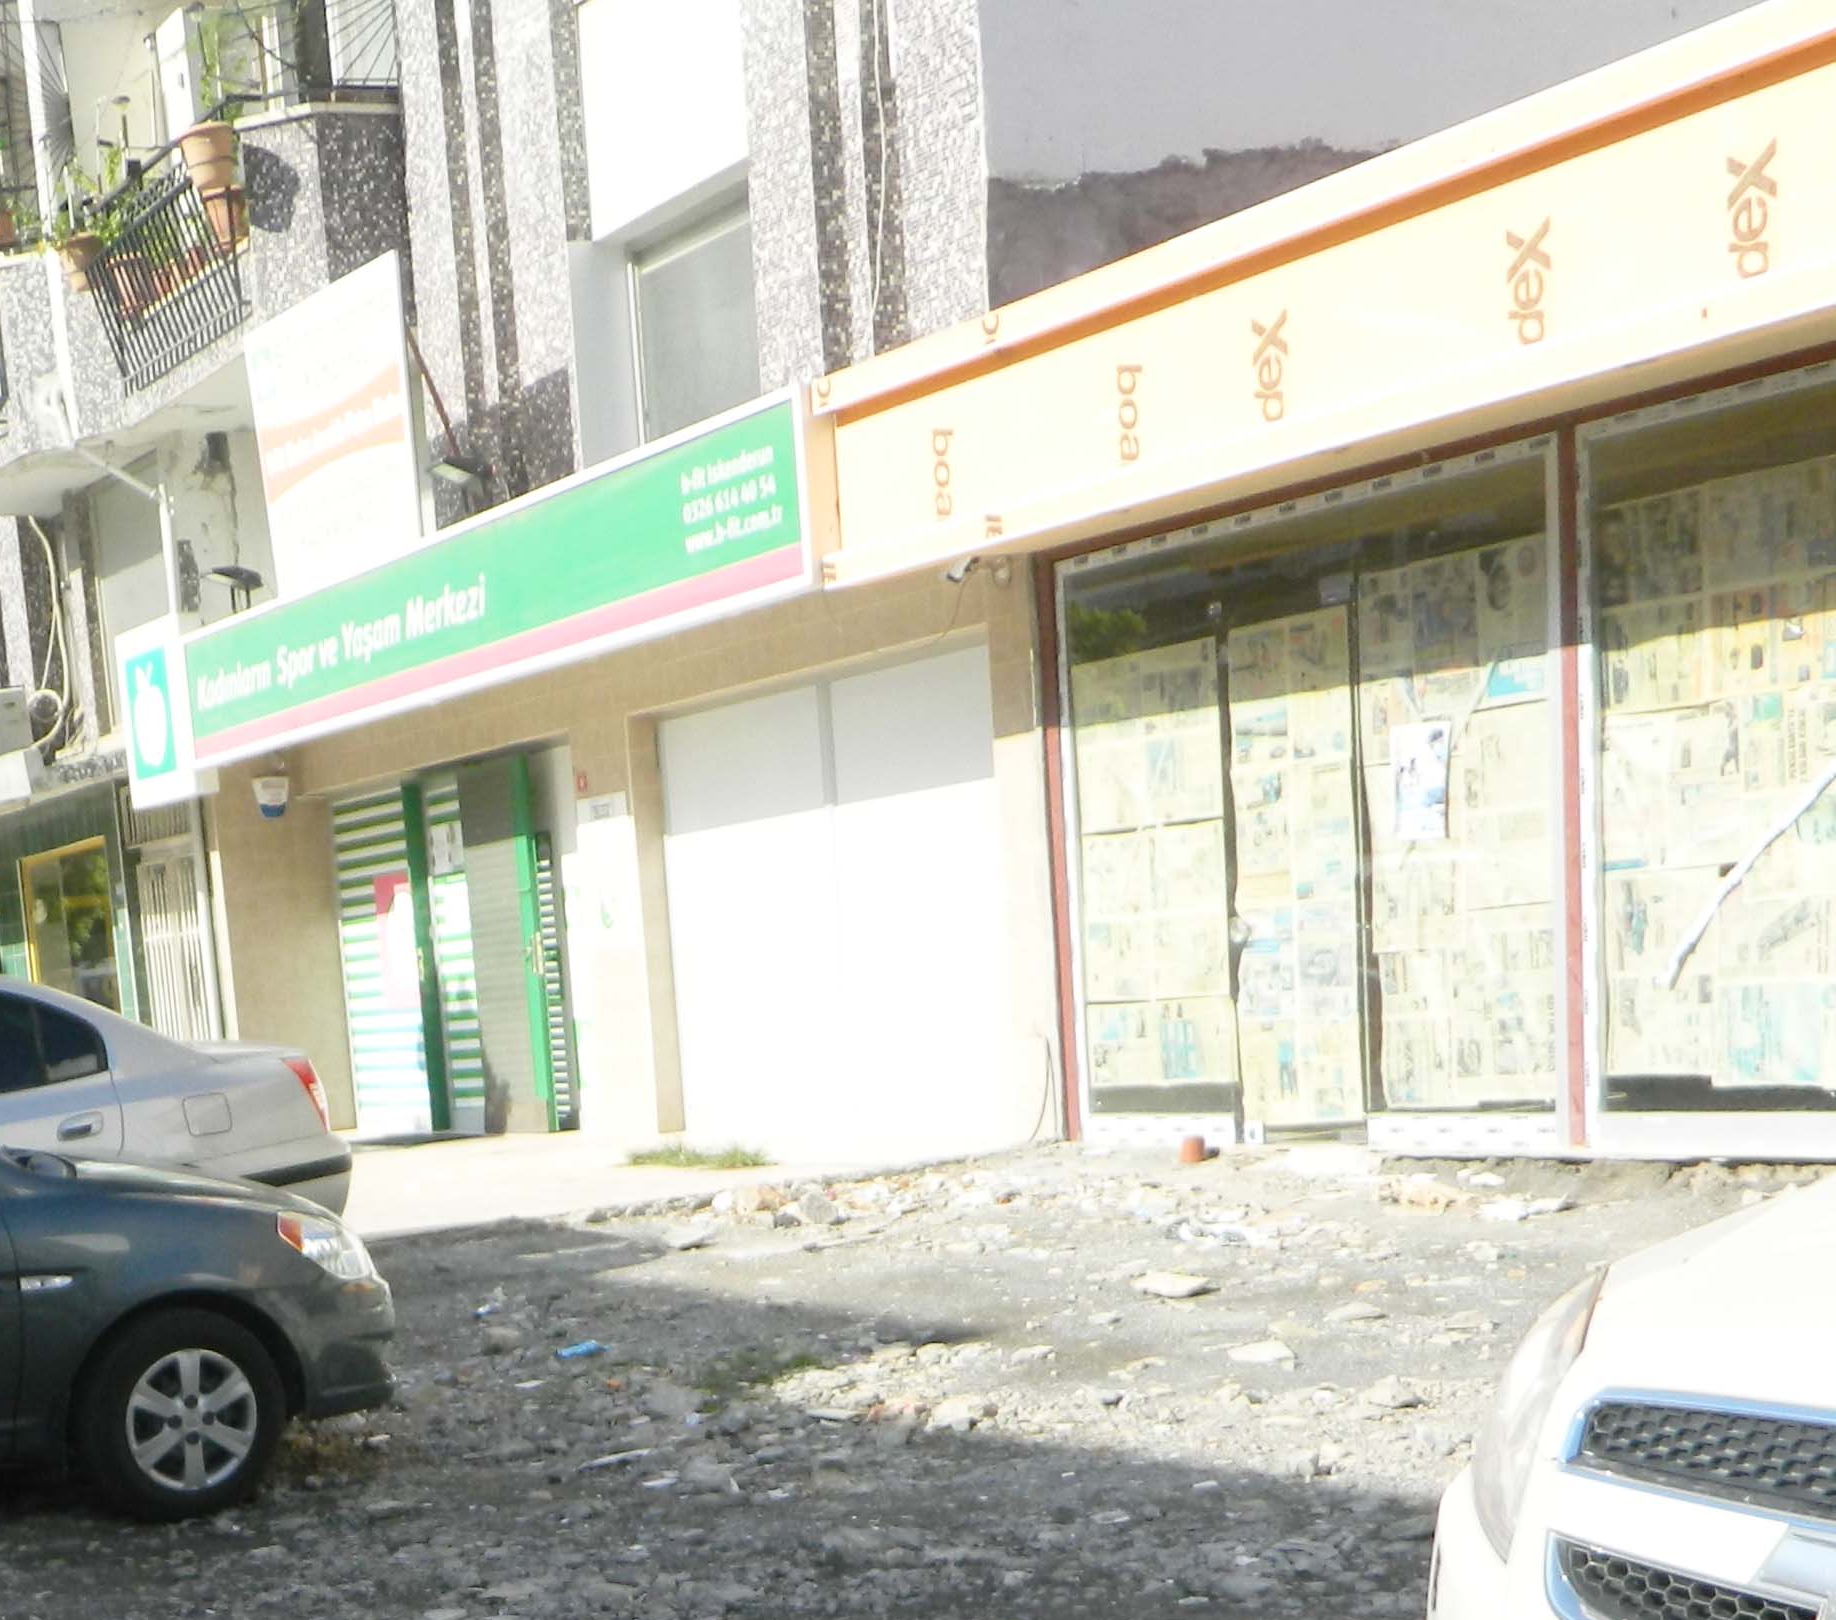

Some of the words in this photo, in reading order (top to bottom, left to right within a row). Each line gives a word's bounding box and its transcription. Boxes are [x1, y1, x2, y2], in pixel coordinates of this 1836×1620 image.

[1116, 363, 1143, 463] boa
[932, 427, 954, 519] boa
[275, 641, 316, 689] Spor
[318, 636, 338, 668] ve
[341, 614, 401, 664] Yaşam
[405, 572, 486, 640] Merkezi
